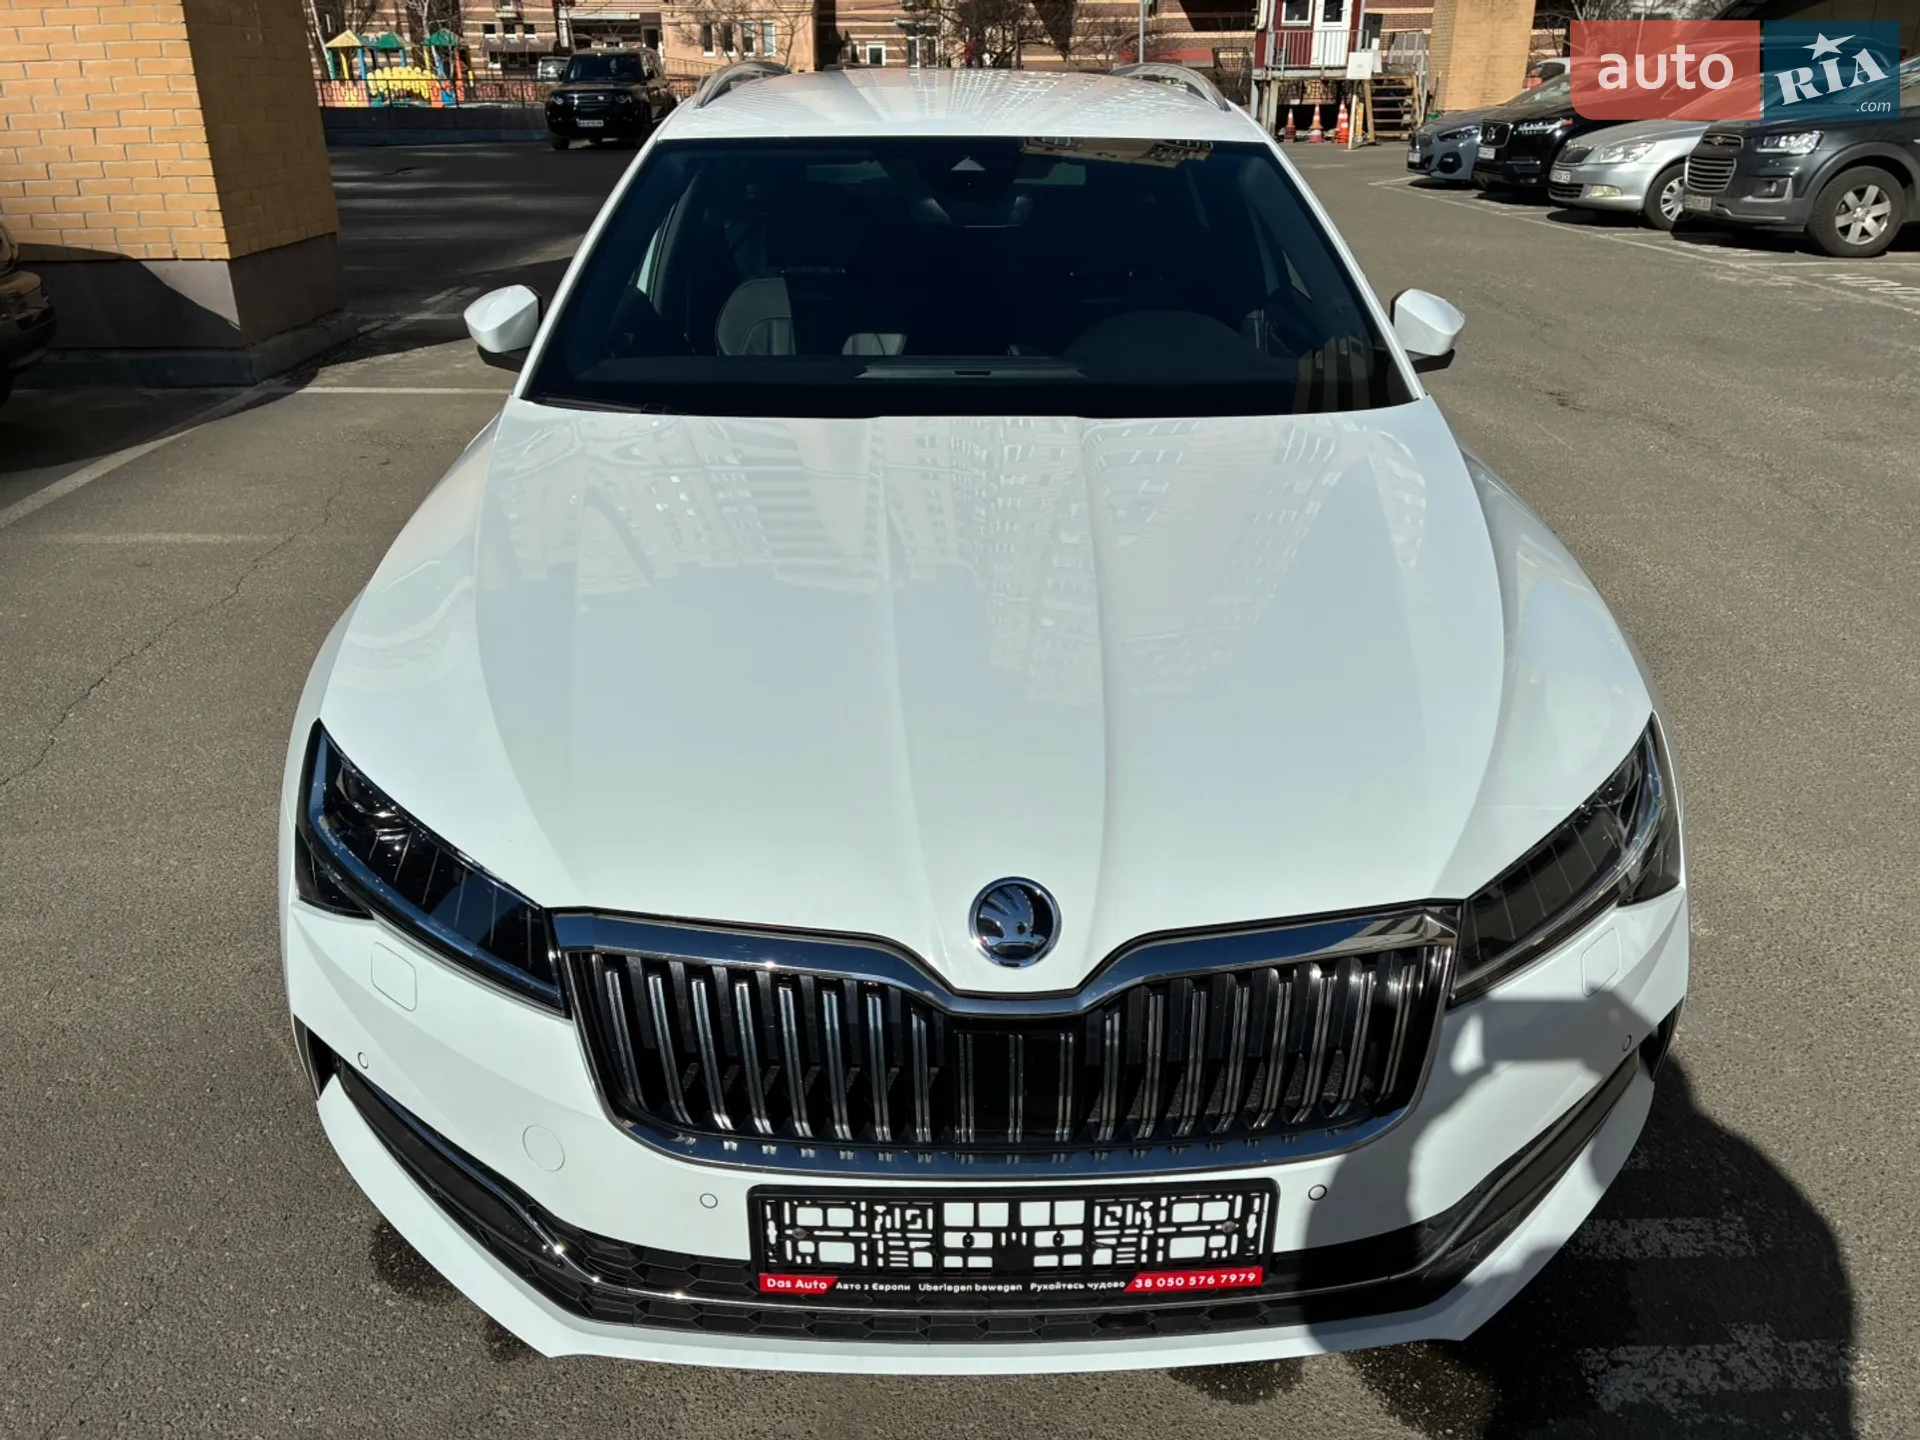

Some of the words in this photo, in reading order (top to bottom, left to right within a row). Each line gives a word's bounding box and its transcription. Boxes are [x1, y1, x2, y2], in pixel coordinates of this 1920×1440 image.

[767, 1278, 792, 1289] Das
[795, 1279, 827, 1290] Auto
[1086, 1281, 1126, 1290] чудово
[1135, 1278, 1153, 1288] 38
[1157, 1277, 1184, 1287] 050
[1189, 1275, 1215, 1286] 576
[1220, 1273, 1256, 1284] 7979
[835, 1281, 861, 1290] Авто
[871, 1282, 911, 1292] Європи
[918, 1283, 973, 1293] Uberlegen
[974, 1283, 1023, 1293] bewegen
